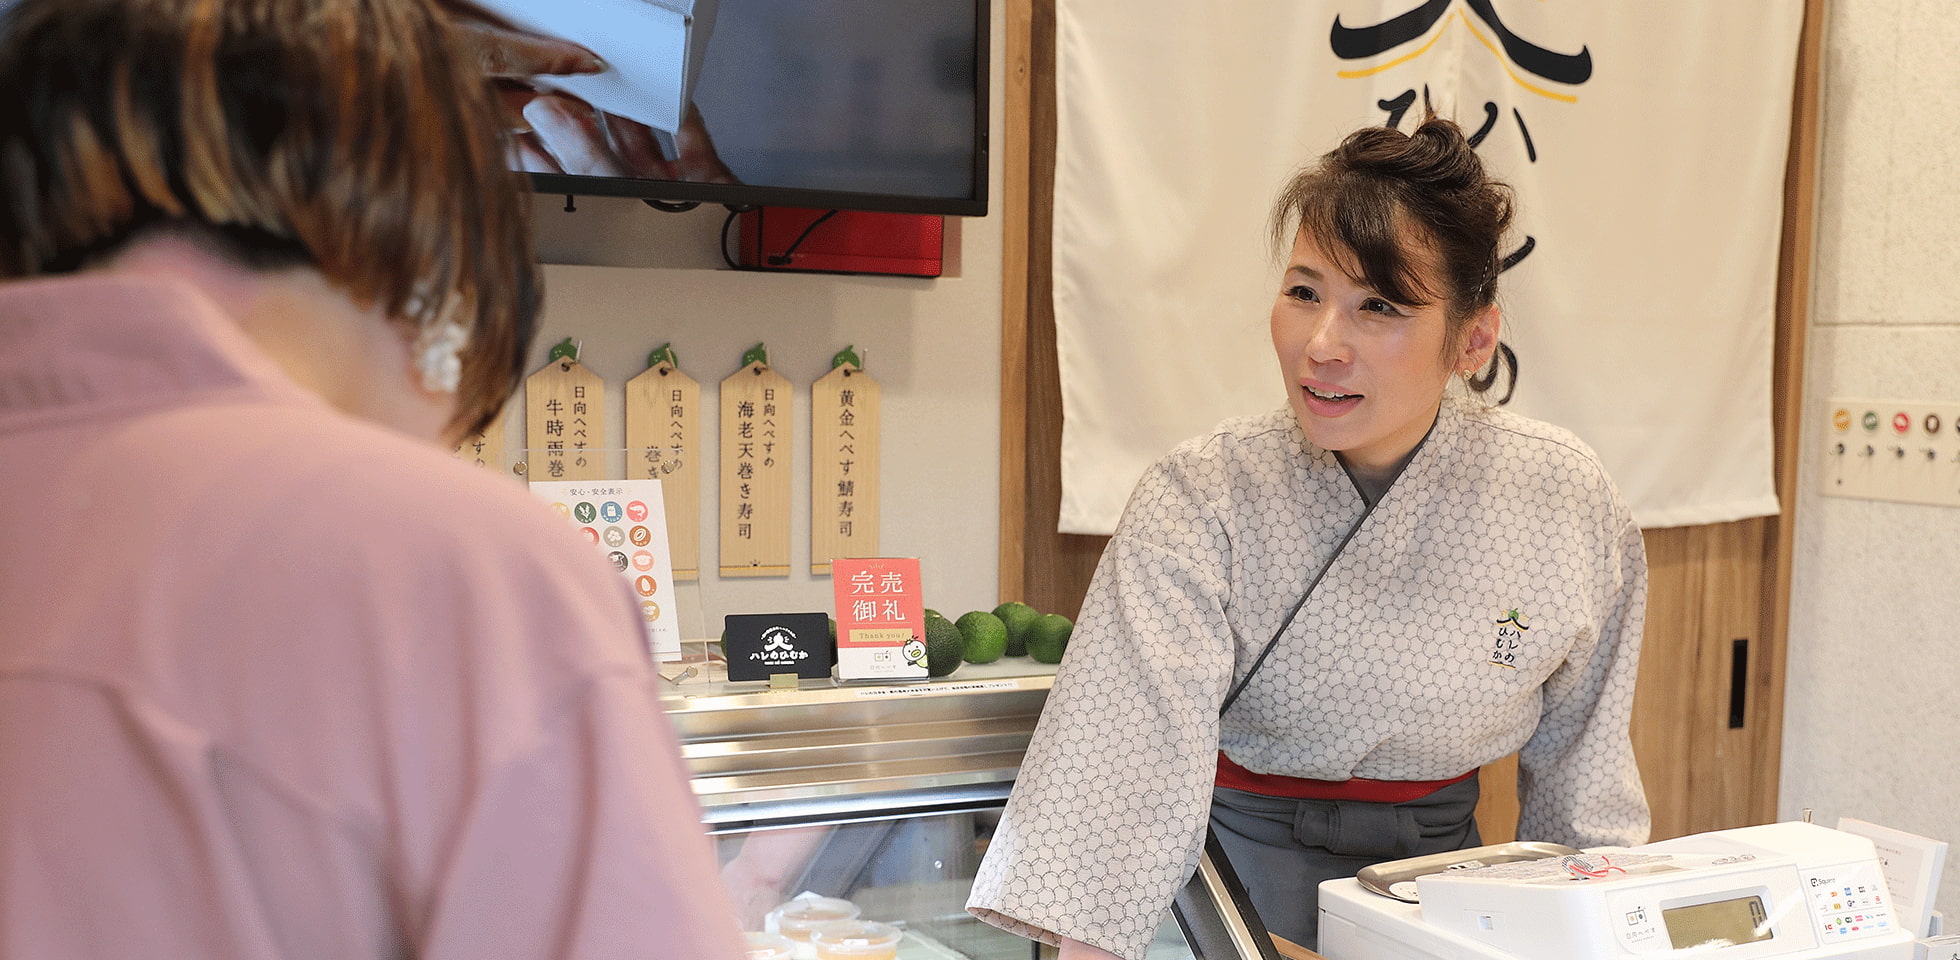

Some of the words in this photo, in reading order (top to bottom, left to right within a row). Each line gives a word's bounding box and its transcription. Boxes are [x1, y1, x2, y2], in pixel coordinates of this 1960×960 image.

[546, 399, 565, 477] 牛時雨巻
[573, 386, 587, 468] 日向へべすの
[763, 388, 776, 468] 日向へべすの
[837, 390, 855, 537] 黄金へべす鯖寿司
[737, 401, 754, 540] 海老天巻き寿司
[850, 570, 903, 594] 完売
[852, 599, 906, 622] 御礼
[1492, 627, 1508, 660] ひむか
[1505, 630, 1521, 663] ハレの
